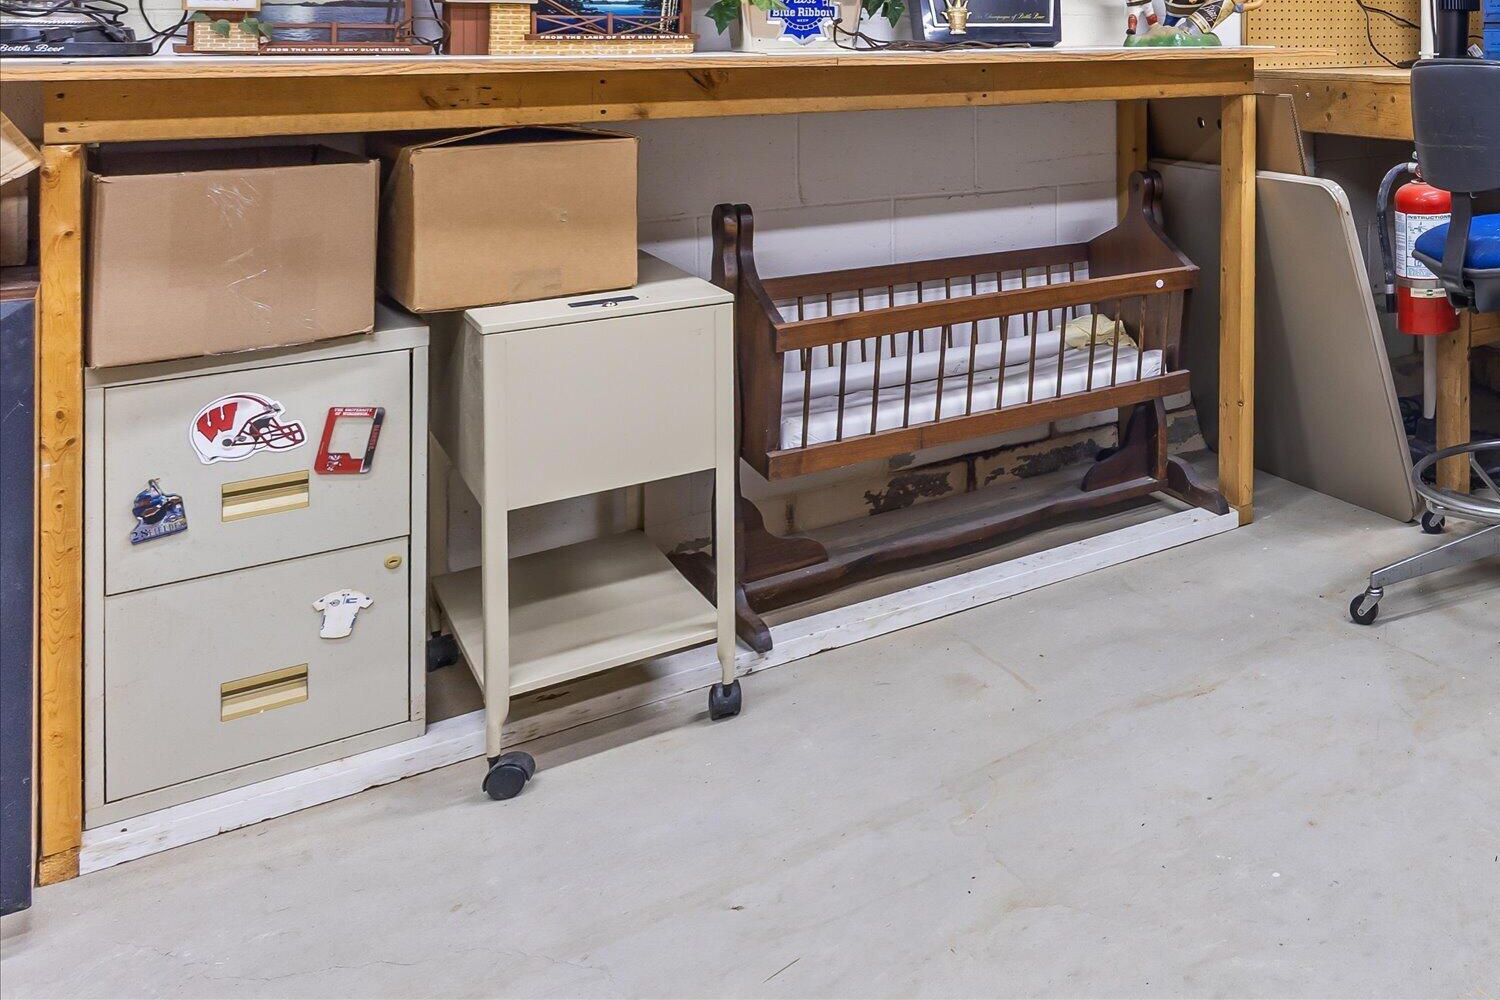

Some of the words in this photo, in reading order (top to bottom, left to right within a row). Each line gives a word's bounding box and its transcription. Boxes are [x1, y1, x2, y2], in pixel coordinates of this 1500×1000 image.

[772, 7, 796, 17] Blue
[798, 6, 834, 17] Ribbon
[196, 402, 238, 443] W
